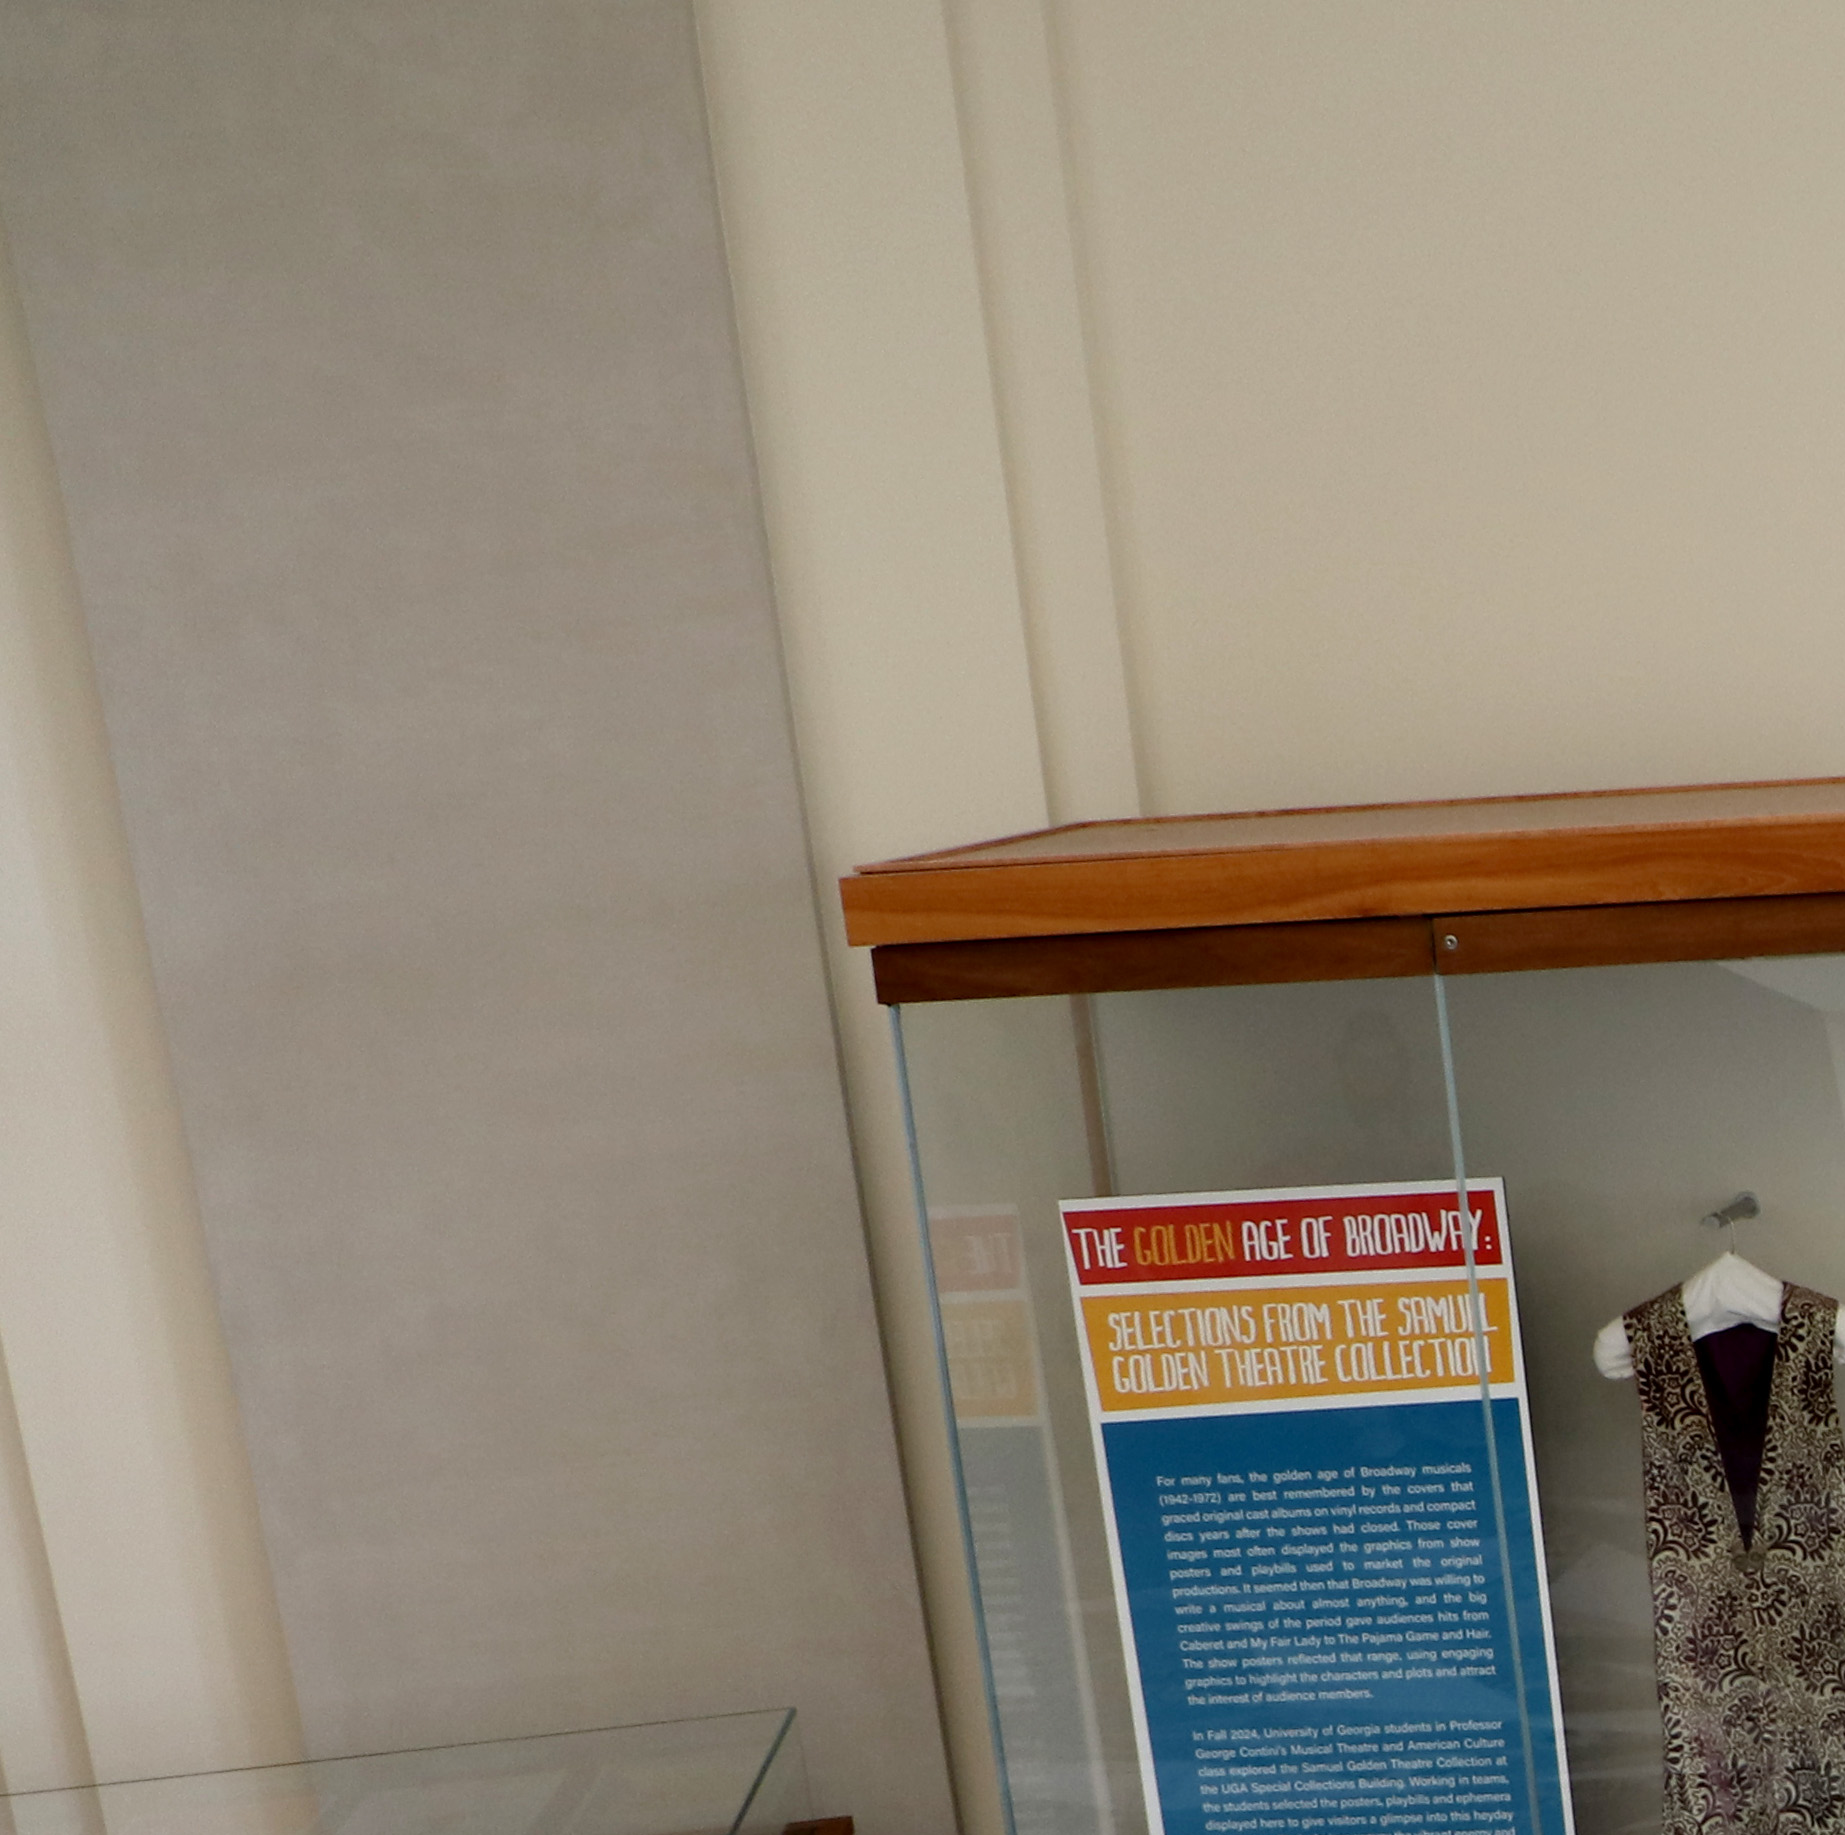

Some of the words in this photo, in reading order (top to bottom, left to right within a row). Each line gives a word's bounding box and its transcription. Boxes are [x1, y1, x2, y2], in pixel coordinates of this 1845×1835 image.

[1072, 1227, 1127, 1270] THE
[1134, 1221, 1237, 1267] GOLDEN
[1242, 1218, 1293, 1262] AGE
[1301, 1216, 1333, 1259] OF
[1343, 1208, 1492, 1258] BROADWAY:
[1108, 1305, 1256, 1351] SELECTIONS
[1264, 1302, 1332, 1344] FROM
[1338, 1299, 1386, 1337] THE
[1112, 1351, 1209, 1394] GOLDEN
[1219, 1345, 1328, 1387] THEATRE
[1336, 1336, 1492, 1382] COLLECTION
[1155, 1475, 1176, 1487] For
[1180, 1475, 1212, 1487] many
[1216, 1472, 1245, 1484] fans,
[1247, 1471, 1268, 1482] the
[1272, 1469, 1312, 1484] golden
[1316, 1470, 1339, 1482] age
[1342, 1466, 1355, 1478] of
[1359, 1465, 1417, 1478] Broadway
[1421, 1462, 1472, 1474] musicals
[1158, 1492, 1222, 1506] (1942-1972)
[1227, 1492, 1247, 1502] are
[1251, 1490, 1278, 1501] best
[1282, 1486, 1356, 1499] remembered
[1360, 1485, 1376, 1498] by
[1381, 1484, 1401, 1495] the
[1406, 1483, 1445, 1494] covers
[1450, 1481, 1474, 1492] that
[1160, 1511, 1201, 1526] graced
[1201, 1509, 1244, 1524] original
[1244, 1508, 1270, 1520] cast
[1270, 1507, 1313, 1519] albums
[1313, 1507, 1329, 1517] on
[1329, 1503, 1357, 1517] vinyl
[1357, 1502, 1402, 1515] records
[1402, 1501, 1425, 1513] and
[1425, 1499, 1476, 1512] compact
[1163, 1530, 1194, 1542] discs
[1198, 1530, 1230, 1542] years
[1235, 1527, 1261, 1539] after
[1265, 1526, 1286, 1537] the
[1290, 1525, 1328, 1536] shows
[1332, 1522, 1355, 1534] had
[1405, 1519, 1441, 1531] Those
[1445, 1519, 1478, 1530] cover
[1166, 1550, 1208, 1562] images
[1212, 1547, 1242, 1558] most
[1245, 1545, 1276, 1557] often
[1280, 1542, 1334, 1556] displayed
[1338, 1541, 1358, 1553] the
[1362, 1539, 1413, 1554] graphics
[1417, 1537, 1445, 1549] from
[1449, 1536, 1481, 1548] show
[1168, 1567, 1212, 1580] posters
[1219, 1564, 1243, 1576] and
[1250, 1562, 1297, 1576] playbills
[1305, 1560, 1334, 1573] used
[1341, 1560, 1355, 1571] to
[1363, 1558, 1403, 1570] market
[1411, 1556, 1431, 1568] the
[1439, 1554, 1483, 1568] original
[1191, 1731, 1204, 1741] In
[1206, 1729, 1227, 1741] Fall
[1262, 1727, 1319, 1739] University
[1321, 1724, 1333, 1736] of
[1336, 1724, 1381, 1737] Georgia
[1383, 1722, 1433, 1734] students
[1434, 1722, 1447, 1732] in
[1448, 1719, 1503, 1731] Professor
[1194, 1748, 1236, 1760] George
[1289, 1743, 1333, 1755] Musical
[1336, 1742, 1379, 1753] Theatre
[1381, 1741, 1404, 1752] and
[1407, 1740, 1461, 1750] American
[1462, 1737, 1505, 1749] Culture
